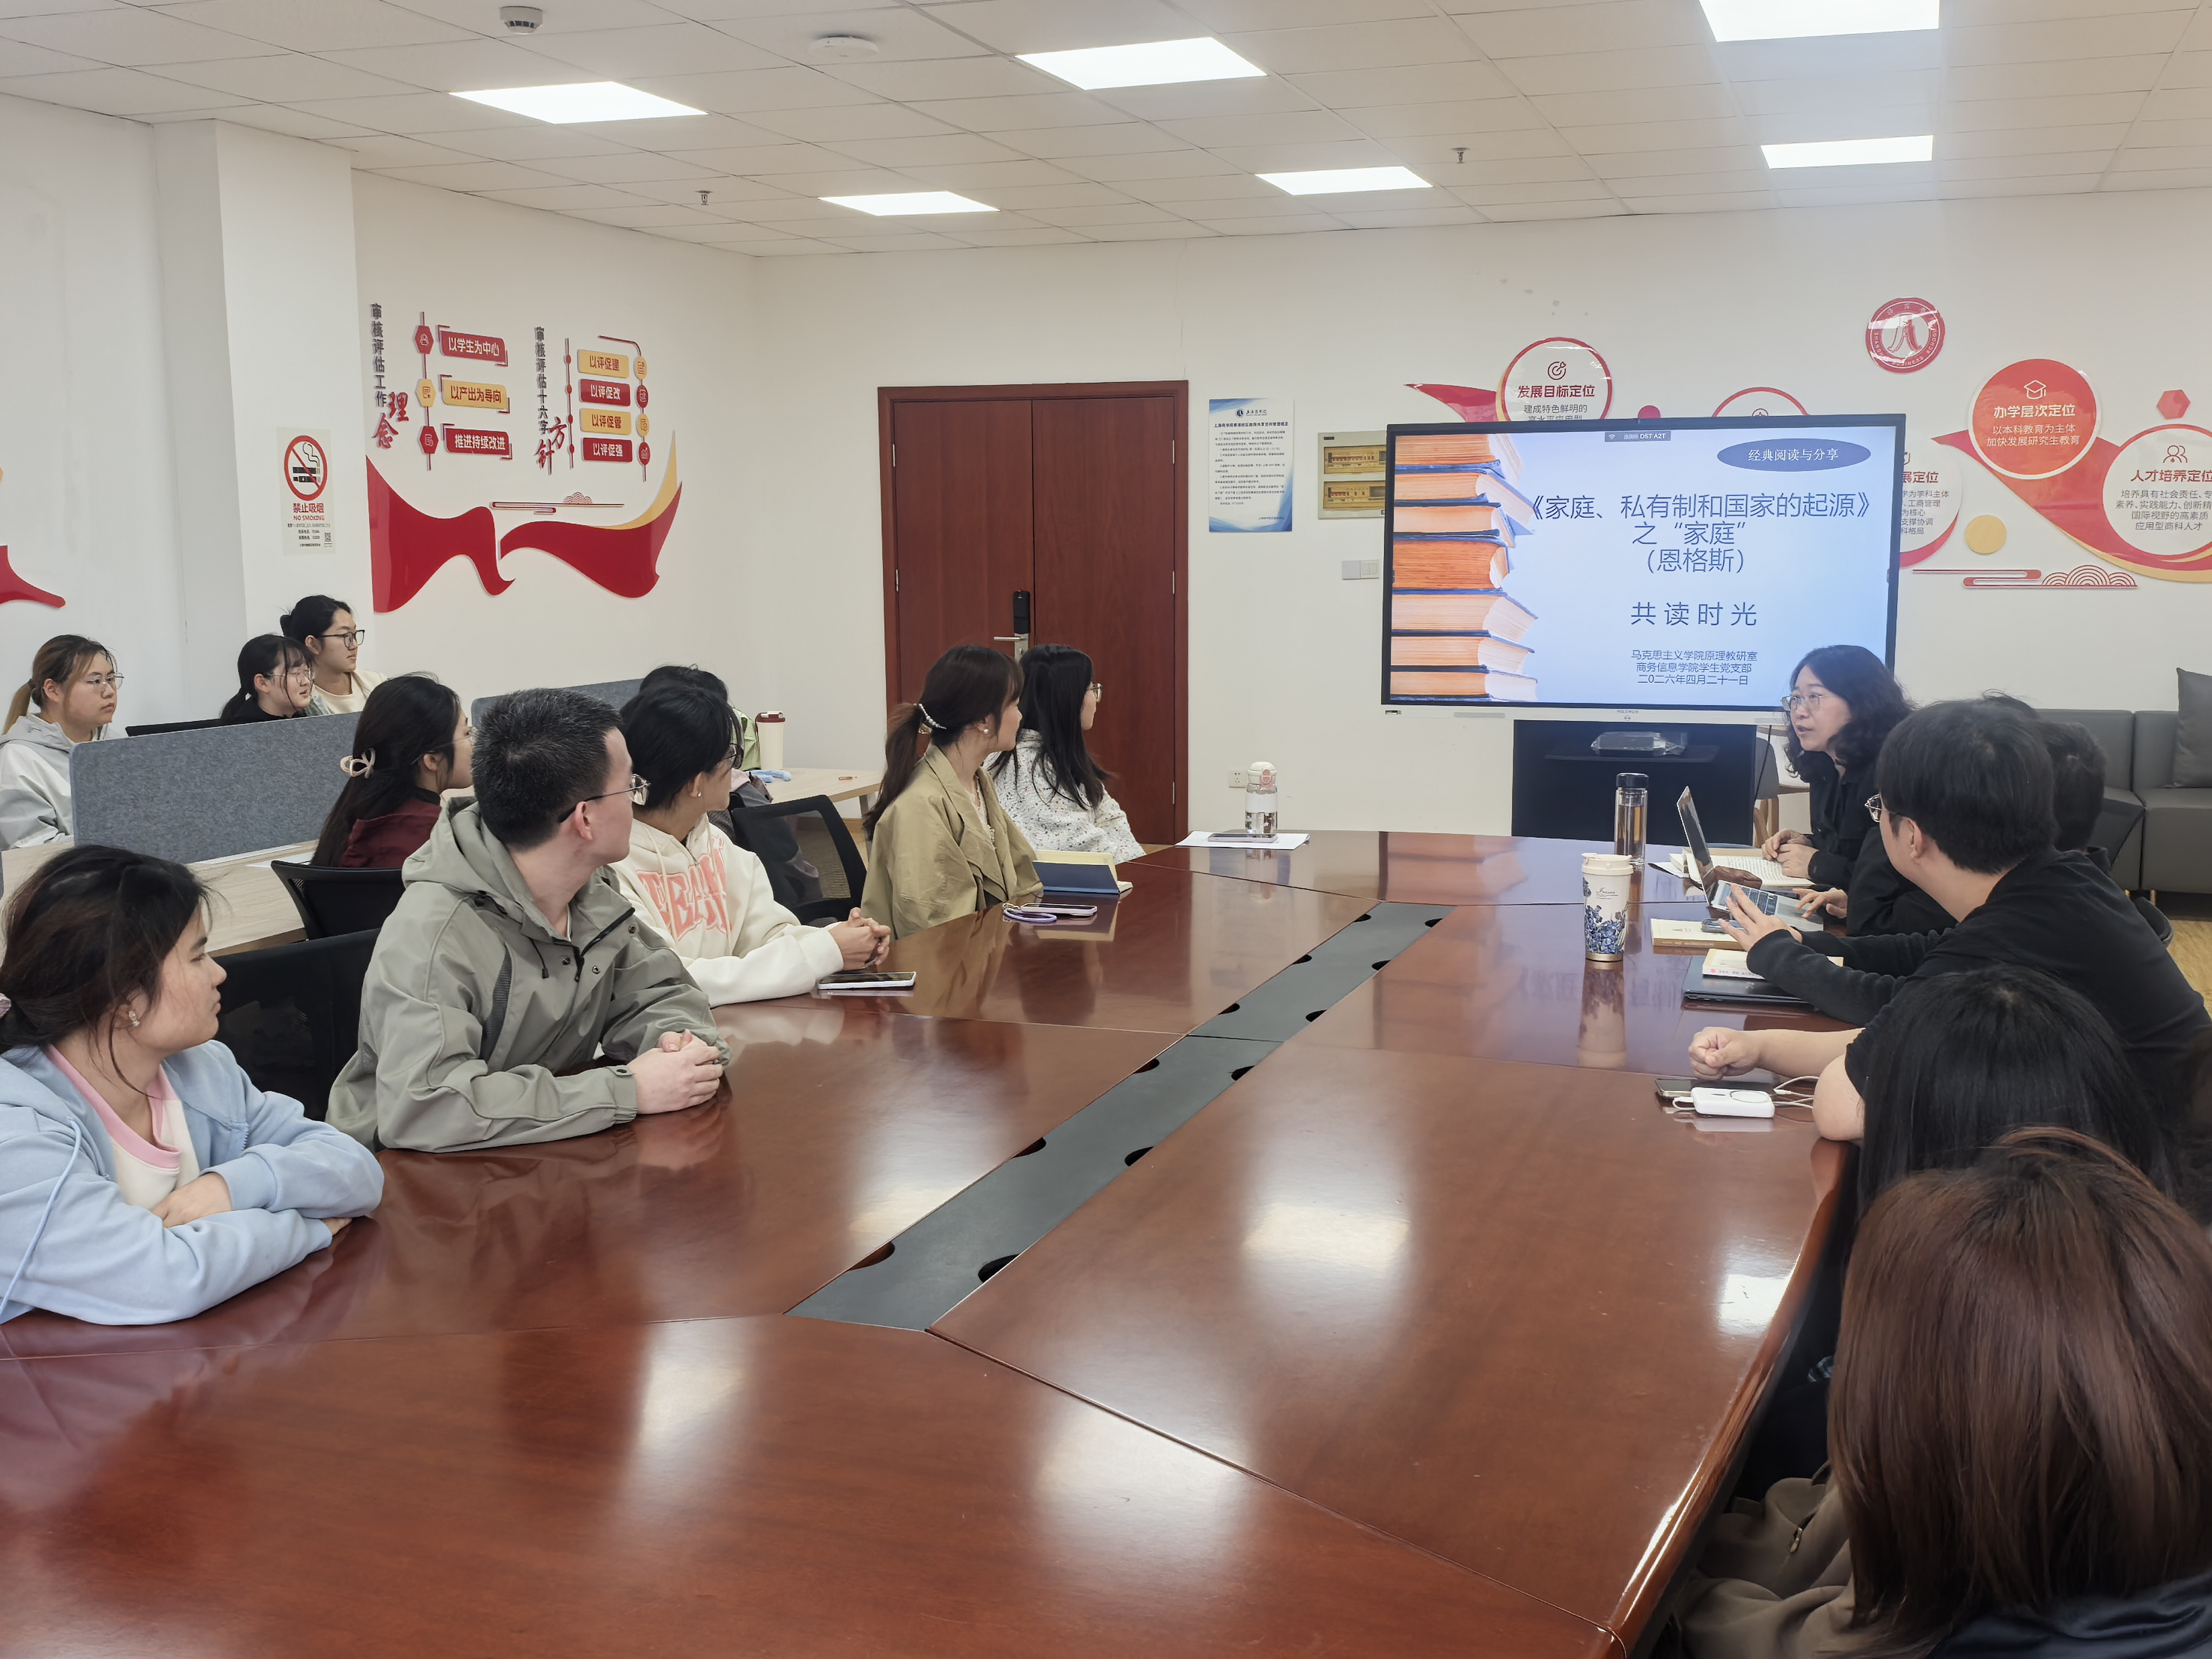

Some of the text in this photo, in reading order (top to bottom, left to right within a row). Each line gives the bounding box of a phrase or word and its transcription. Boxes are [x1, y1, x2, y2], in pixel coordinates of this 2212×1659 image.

[449, 336, 500, 356] 以学生为中心
[370, 303, 387, 408] 审核评估工作
[590, 355, 619, 371] 以评促建
[535, 326, 549, 435] 审核评估十六字
[450, 386, 501, 403] 以产出为导向
[591, 385, 621, 400] 以评促改
[1517, 385, 1595, 398] 发展目标定位
[1524, 404, 1587, 413] 建成特色鲜明的
[1993, 404, 2075, 419] 办学层次定位
[372, 392, 409, 449] 理念
[591, 414, 621, 429] 以评促管
[1993, 423, 2075, 435] 以本科教育为主体
[455, 434, 505, 450] 推进持续改进
[534, 416, 567, 475] 方针
[1986, 435, 2080, 447] 加快发展研究生教育
[593, 443, 623, 457] 以评促强
[1749, 448, 1838, 461] 经典阅读与分享
[2130, 470, 2212, 482] 人才培养定位
[293, 503, 324, 512] 禁止吸烟
[1532, 493, 1871, 520] 《家庭、私有制和国家的起源》
[2132, 511, 2208, 520] 国际视野的高素质
[2135, 521, 2203, 530] 应用型商科人才
[1648, 548, 1744, 574] （恩格斯）
[1631, 602, 1757, 626] 共读时光
[1631, 650, 1758, 662] 马克思主义学院原理教研室
[1636, 662, 1752, 673] 商务信息学院学生党支部
